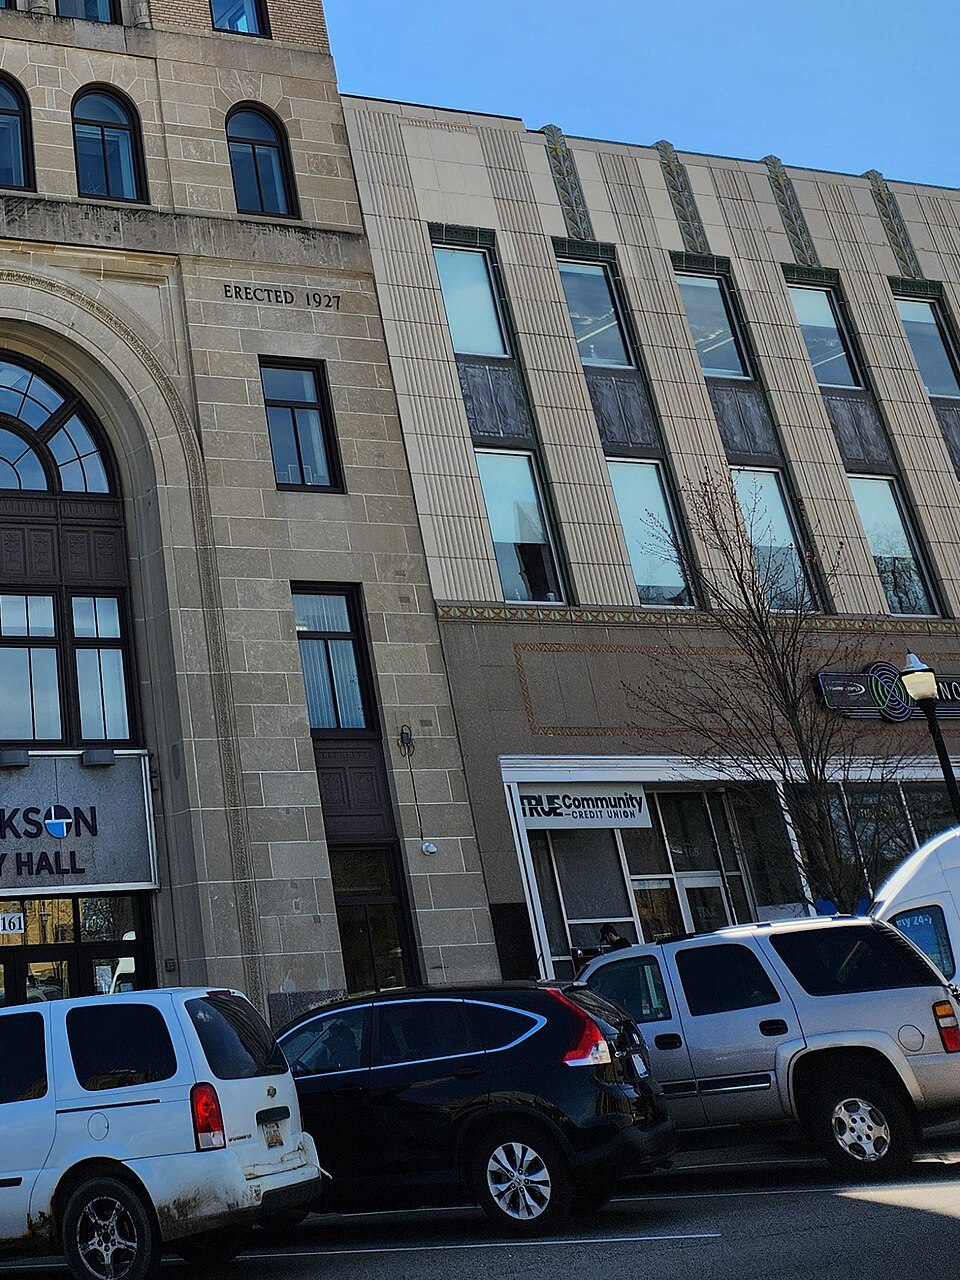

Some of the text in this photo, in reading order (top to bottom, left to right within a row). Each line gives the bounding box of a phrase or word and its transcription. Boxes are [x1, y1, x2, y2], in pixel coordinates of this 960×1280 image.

[223, 284, 341, 310] ERECTED 1927
[519, 792, 643, 817] TRUE Community
[571, 810, 636, 819] CREDIT UNION
[15, 850, 86, 876] HALL
[0, 915, 24, 932] 161
